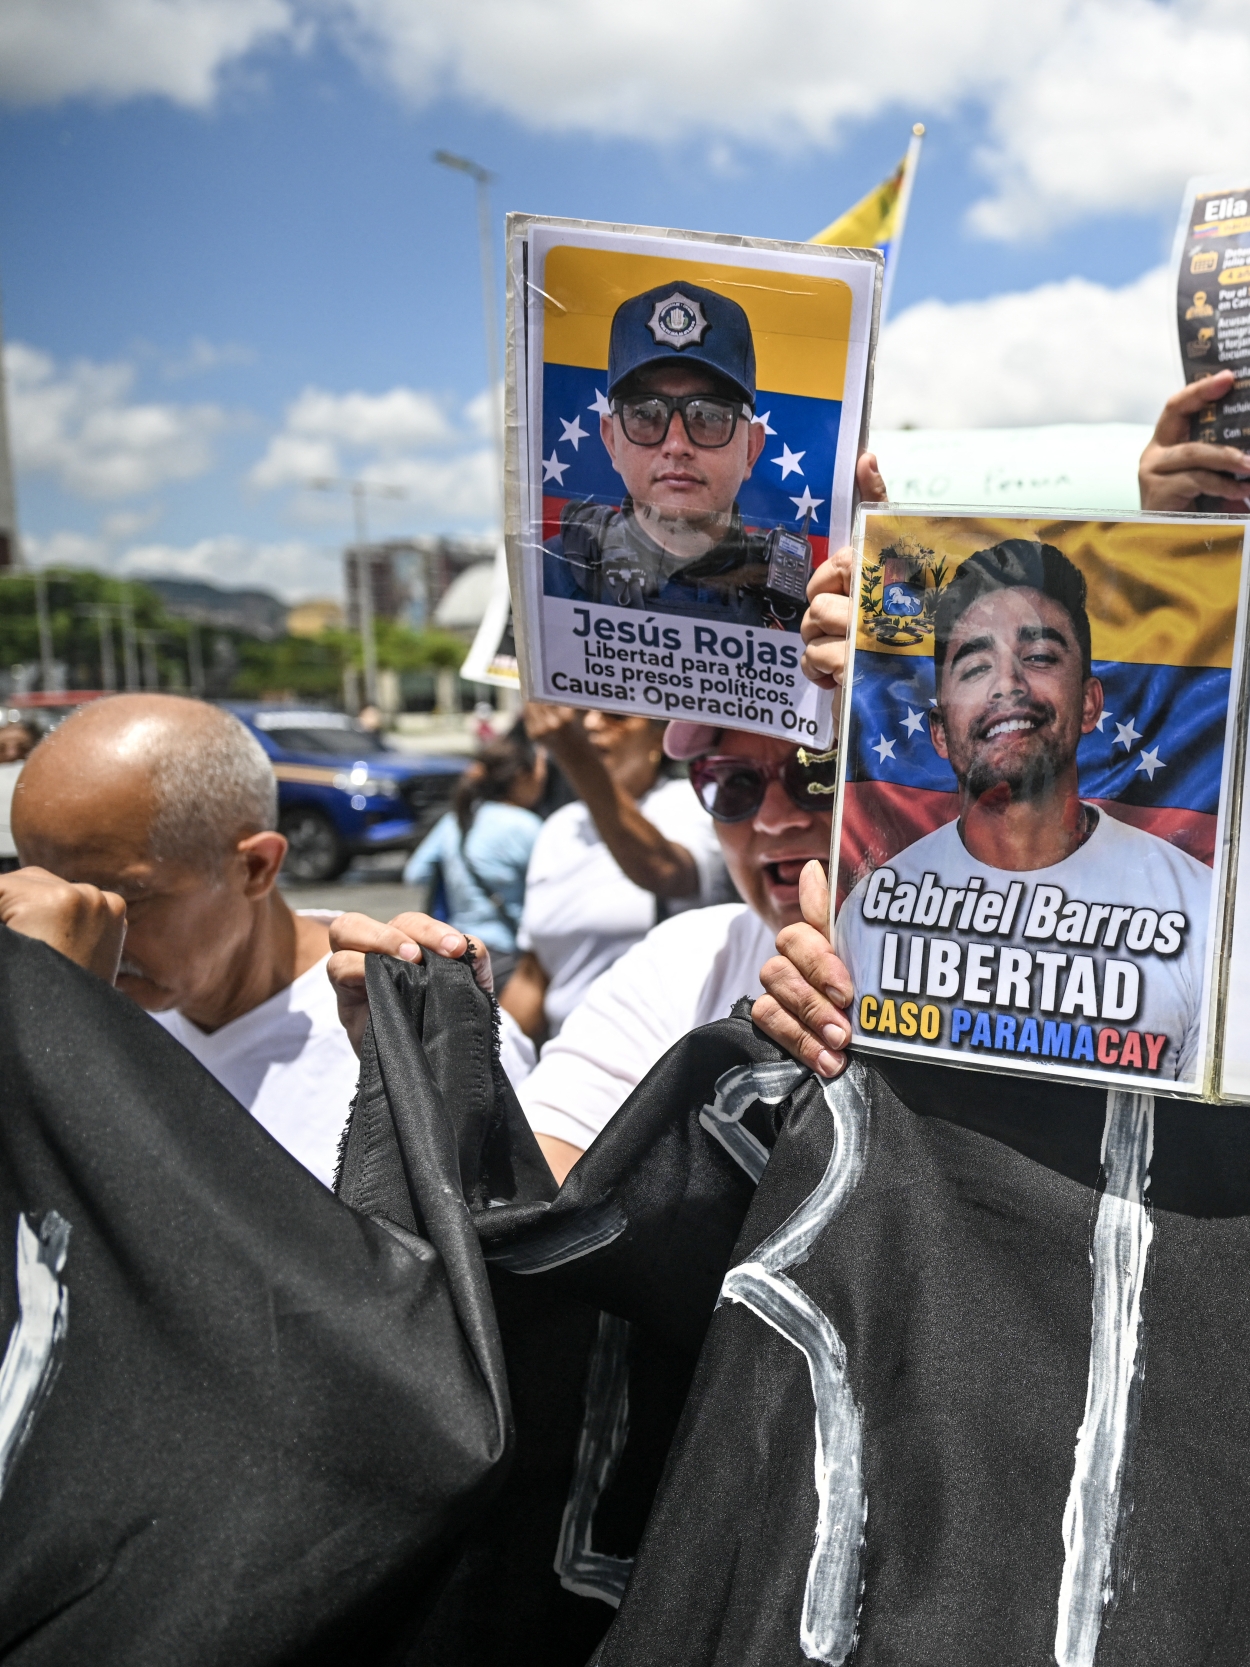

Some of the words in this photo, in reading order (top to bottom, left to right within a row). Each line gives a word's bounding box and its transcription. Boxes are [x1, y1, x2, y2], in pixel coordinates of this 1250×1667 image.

[1204, 197, 1248, 222] Elia
[572, 607, 681, 650] Jesús
[693, 625, 798, 669] Rojas
[584, 640, 674, 668] Libertad
[681, 657, 729, 676] para
[736, 662, 795, 687] todos
[551, 672, 635, 701] Causa:
[643, 686, 774, 725] Operación
[780, 709, 818, 735] Oro
[585, 658, 615, 677] los
[621, 667, 694, 689] presos
[700, 677, 793, 707] políticos.
[862, 866, 1024, 936] Gabriel
[1024, 883, 1187, 955] Barros
[880, 931, 1141, 1021] LIBERTAD
[859, 995, 941, 1040] CASO
[951, 1007, 1167, 1071] PARAMACAY
